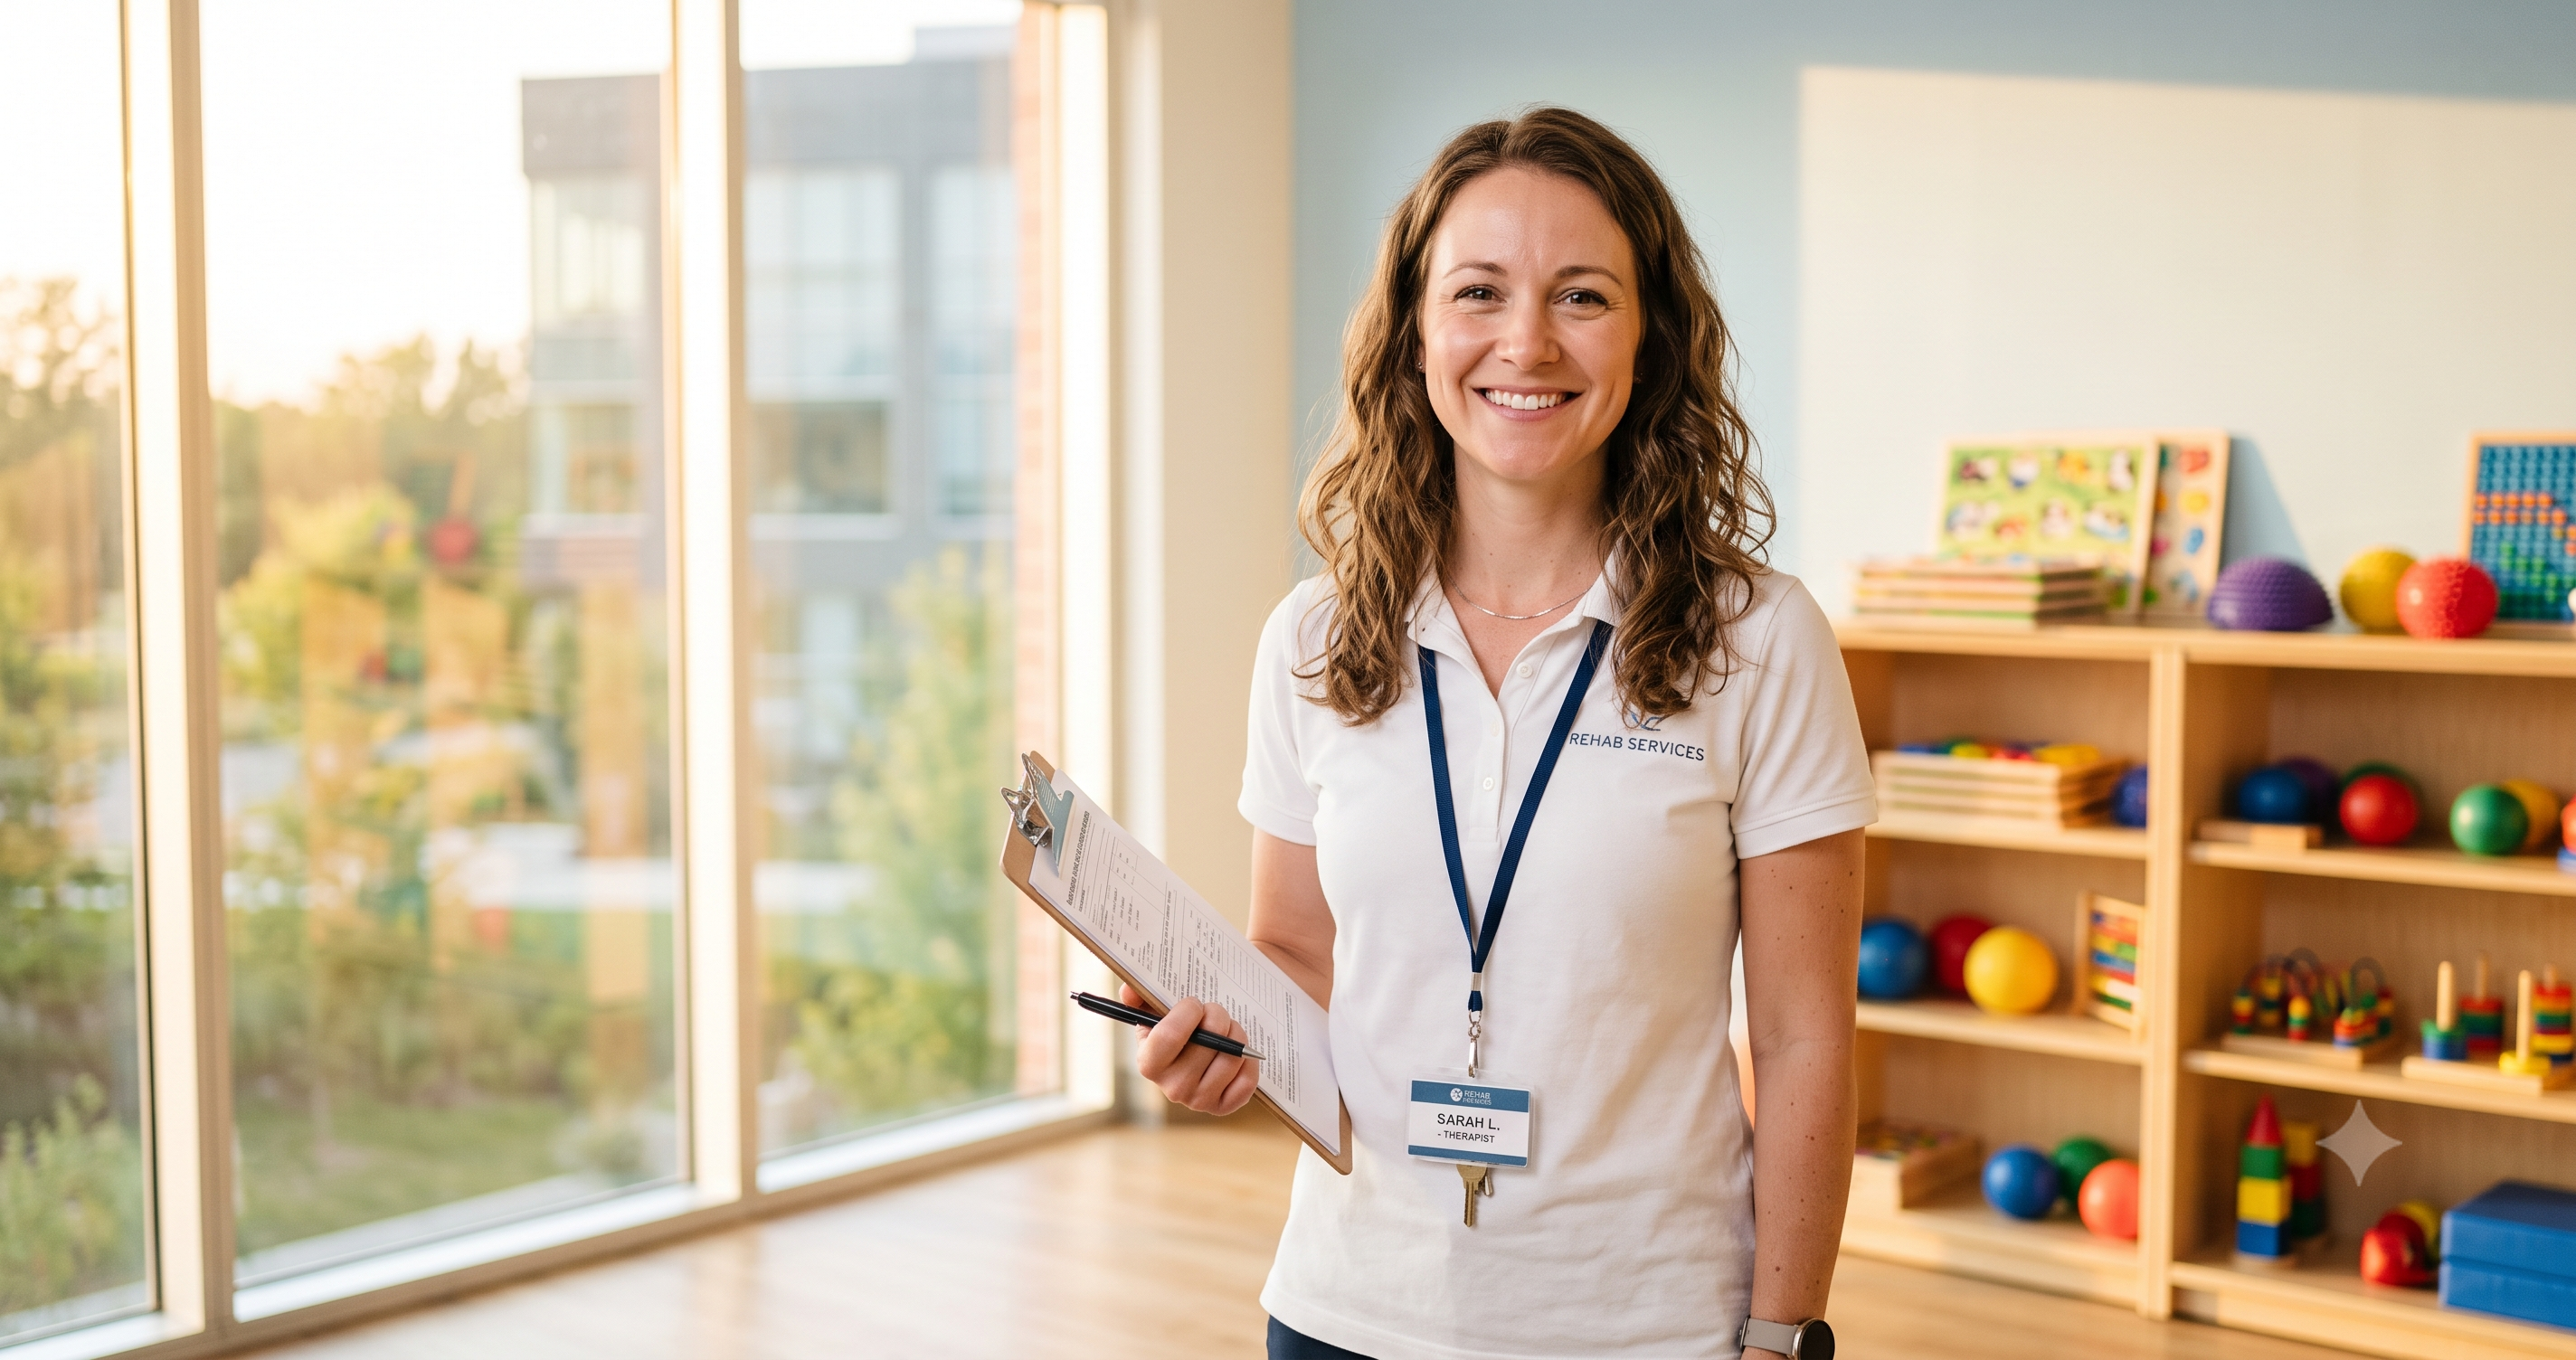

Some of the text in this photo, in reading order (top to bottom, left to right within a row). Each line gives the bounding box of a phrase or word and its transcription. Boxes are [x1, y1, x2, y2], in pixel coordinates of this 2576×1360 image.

[1569, 732, 1705, 761] REHAB SERVICES
[1437, 1113, 1501, 1131] SARAH L.
[1444, 1130, 1495, 1143] THERAPIST
